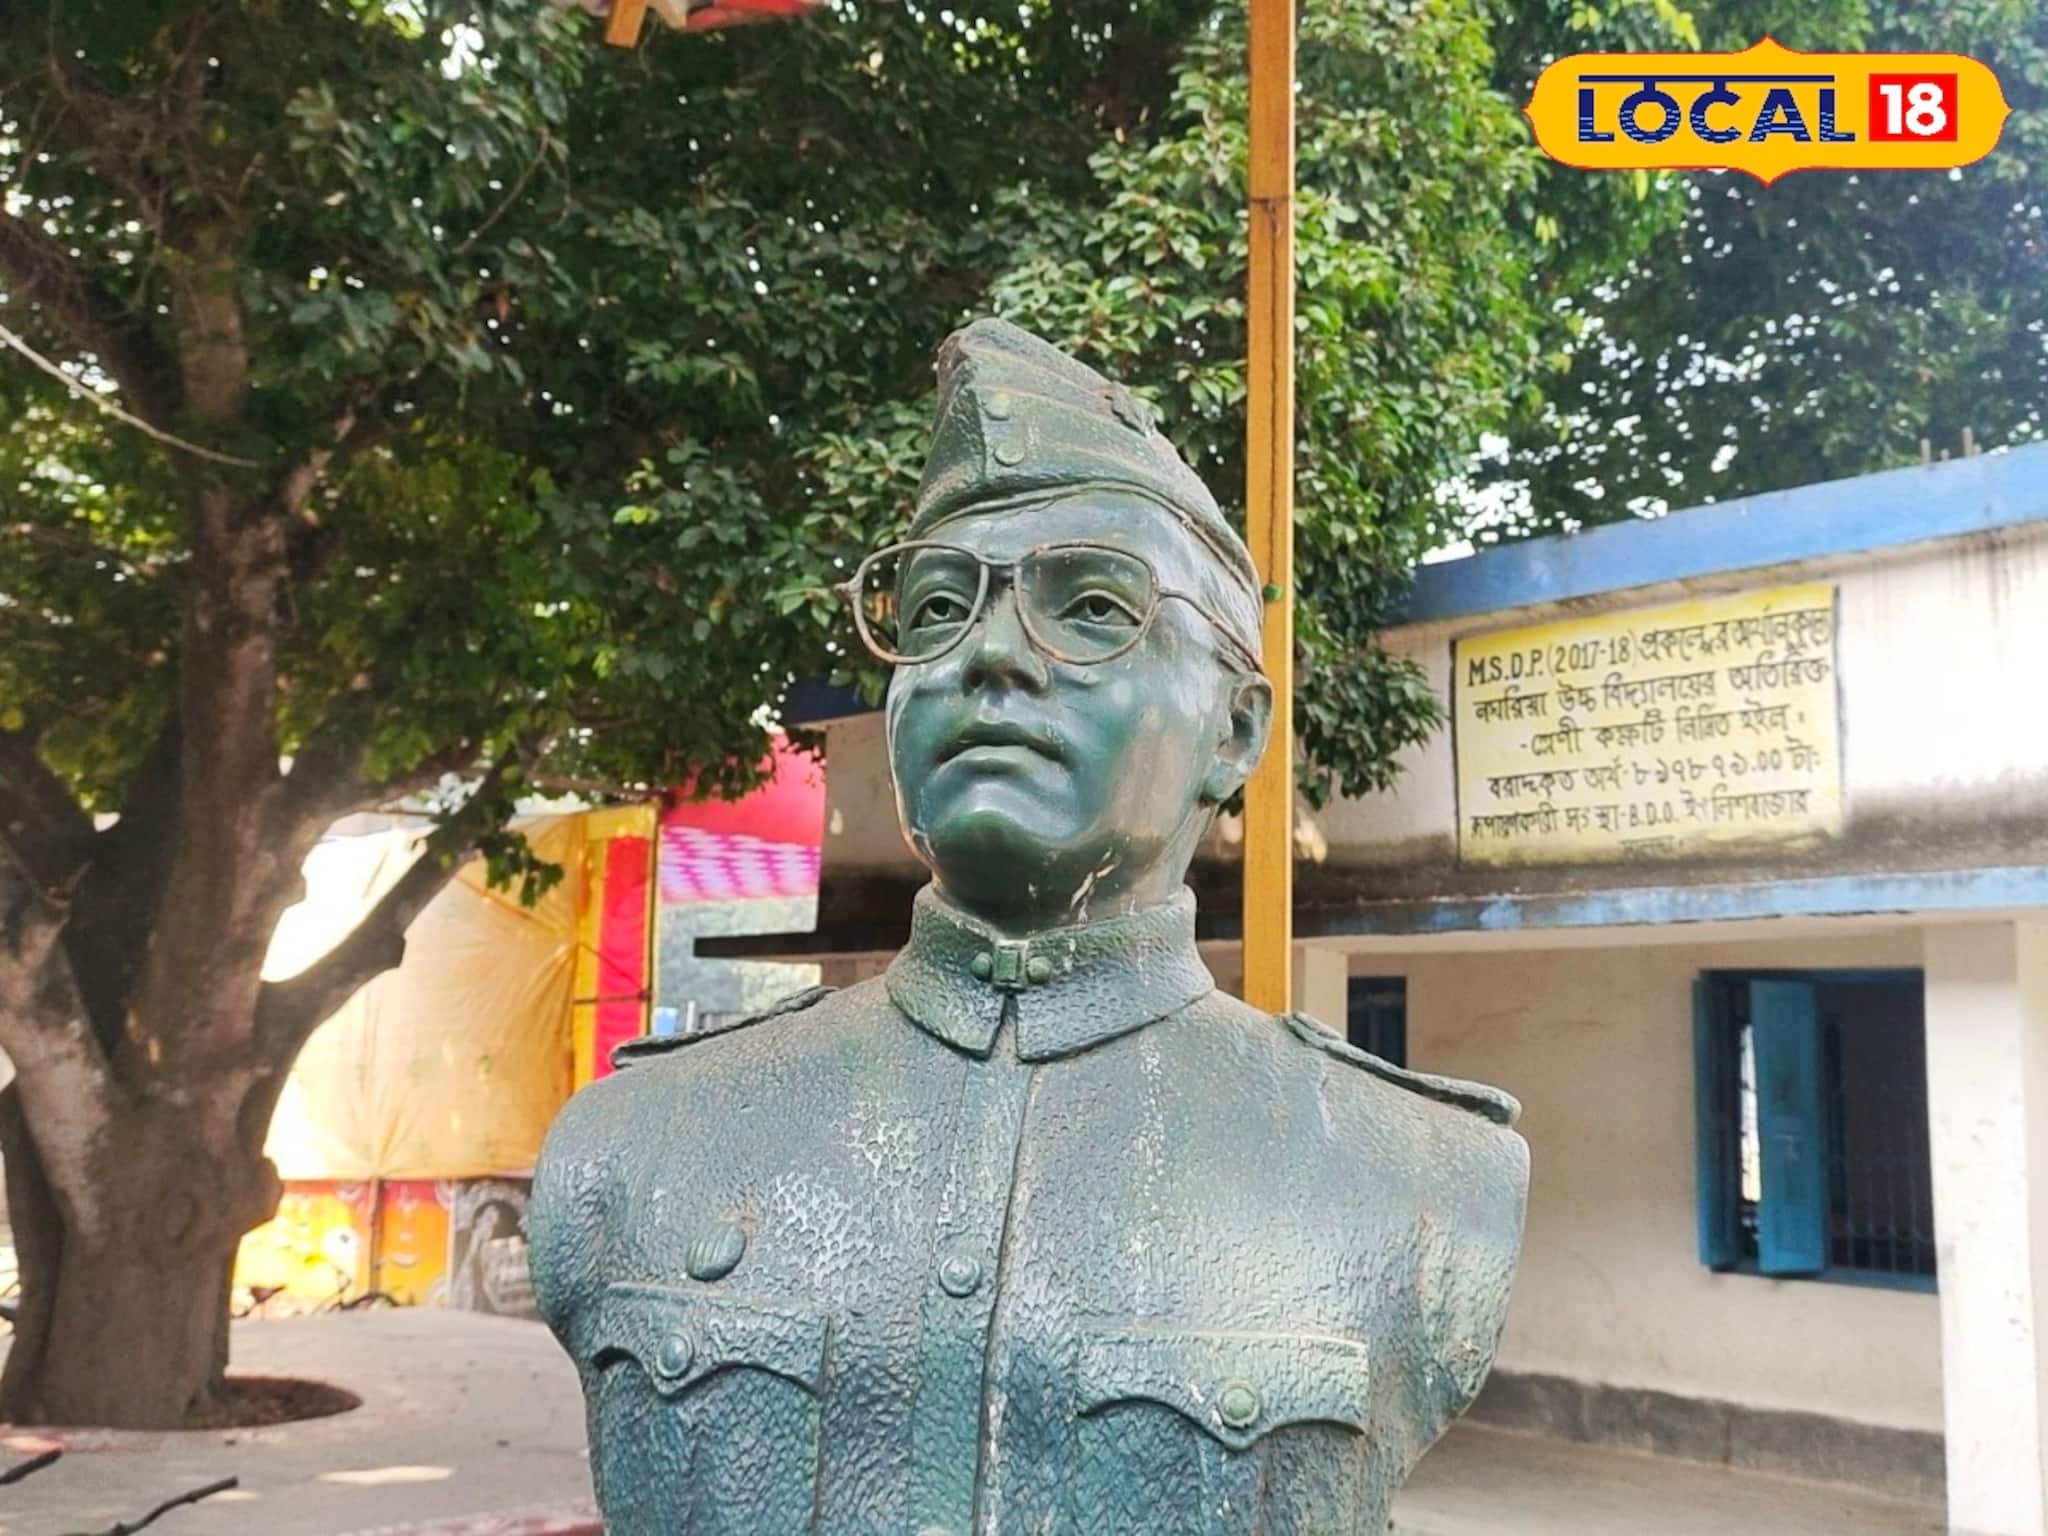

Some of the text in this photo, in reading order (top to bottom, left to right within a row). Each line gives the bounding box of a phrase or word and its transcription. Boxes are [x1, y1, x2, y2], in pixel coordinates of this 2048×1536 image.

[1468, 648, 1544, 687] M.S.D.P.
[1548, 629, 1636, 677] (2017-18)
[1557, 680, 1597, 711] উচ্চ
[1601, 670, 1716, 709] বিদ্যালয়ের
[1728, 650, 1830, 691] অতিরিক্ত
